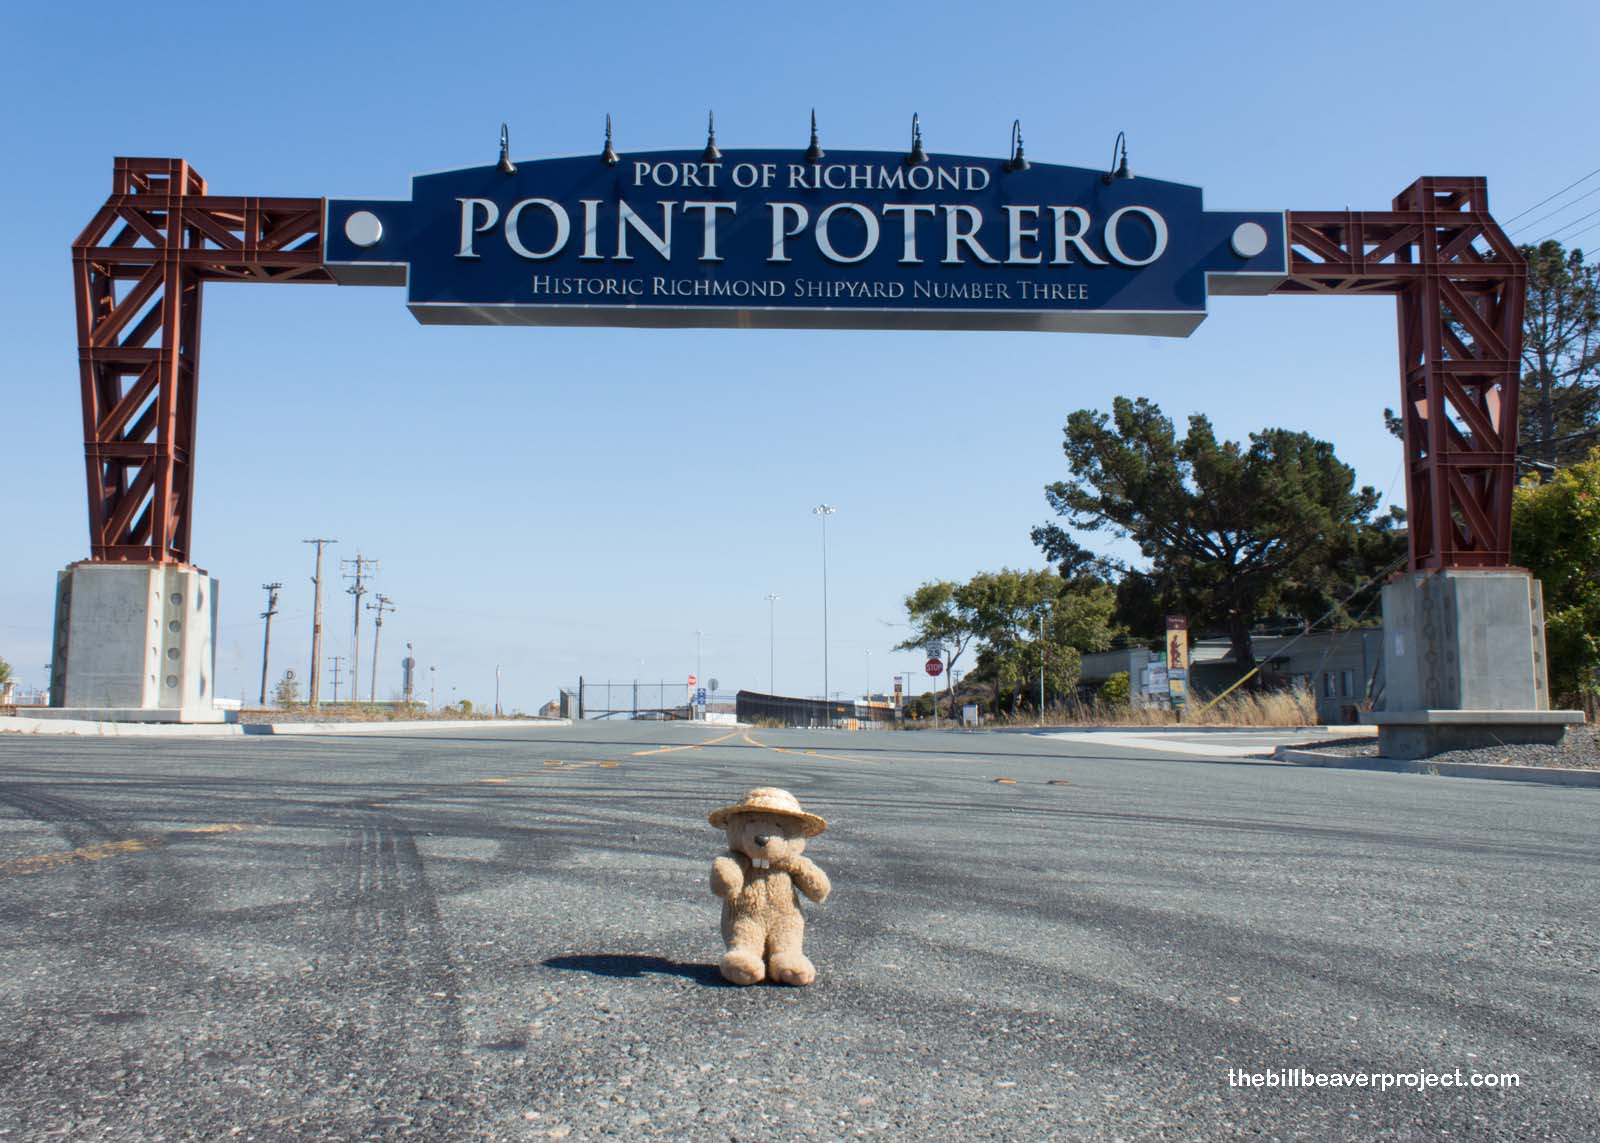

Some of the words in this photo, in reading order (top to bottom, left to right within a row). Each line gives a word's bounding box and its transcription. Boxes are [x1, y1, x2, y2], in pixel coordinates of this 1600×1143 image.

[632, 161, 722, 188] PORT
[732, 163, 776, 189] OF
[787, 163, 990, 191] RICHMOND
[454, 197, 736, 261] POINT
[765, 202, 1168, 267] POTRERO
[926, 663, 942, 672] STOP
